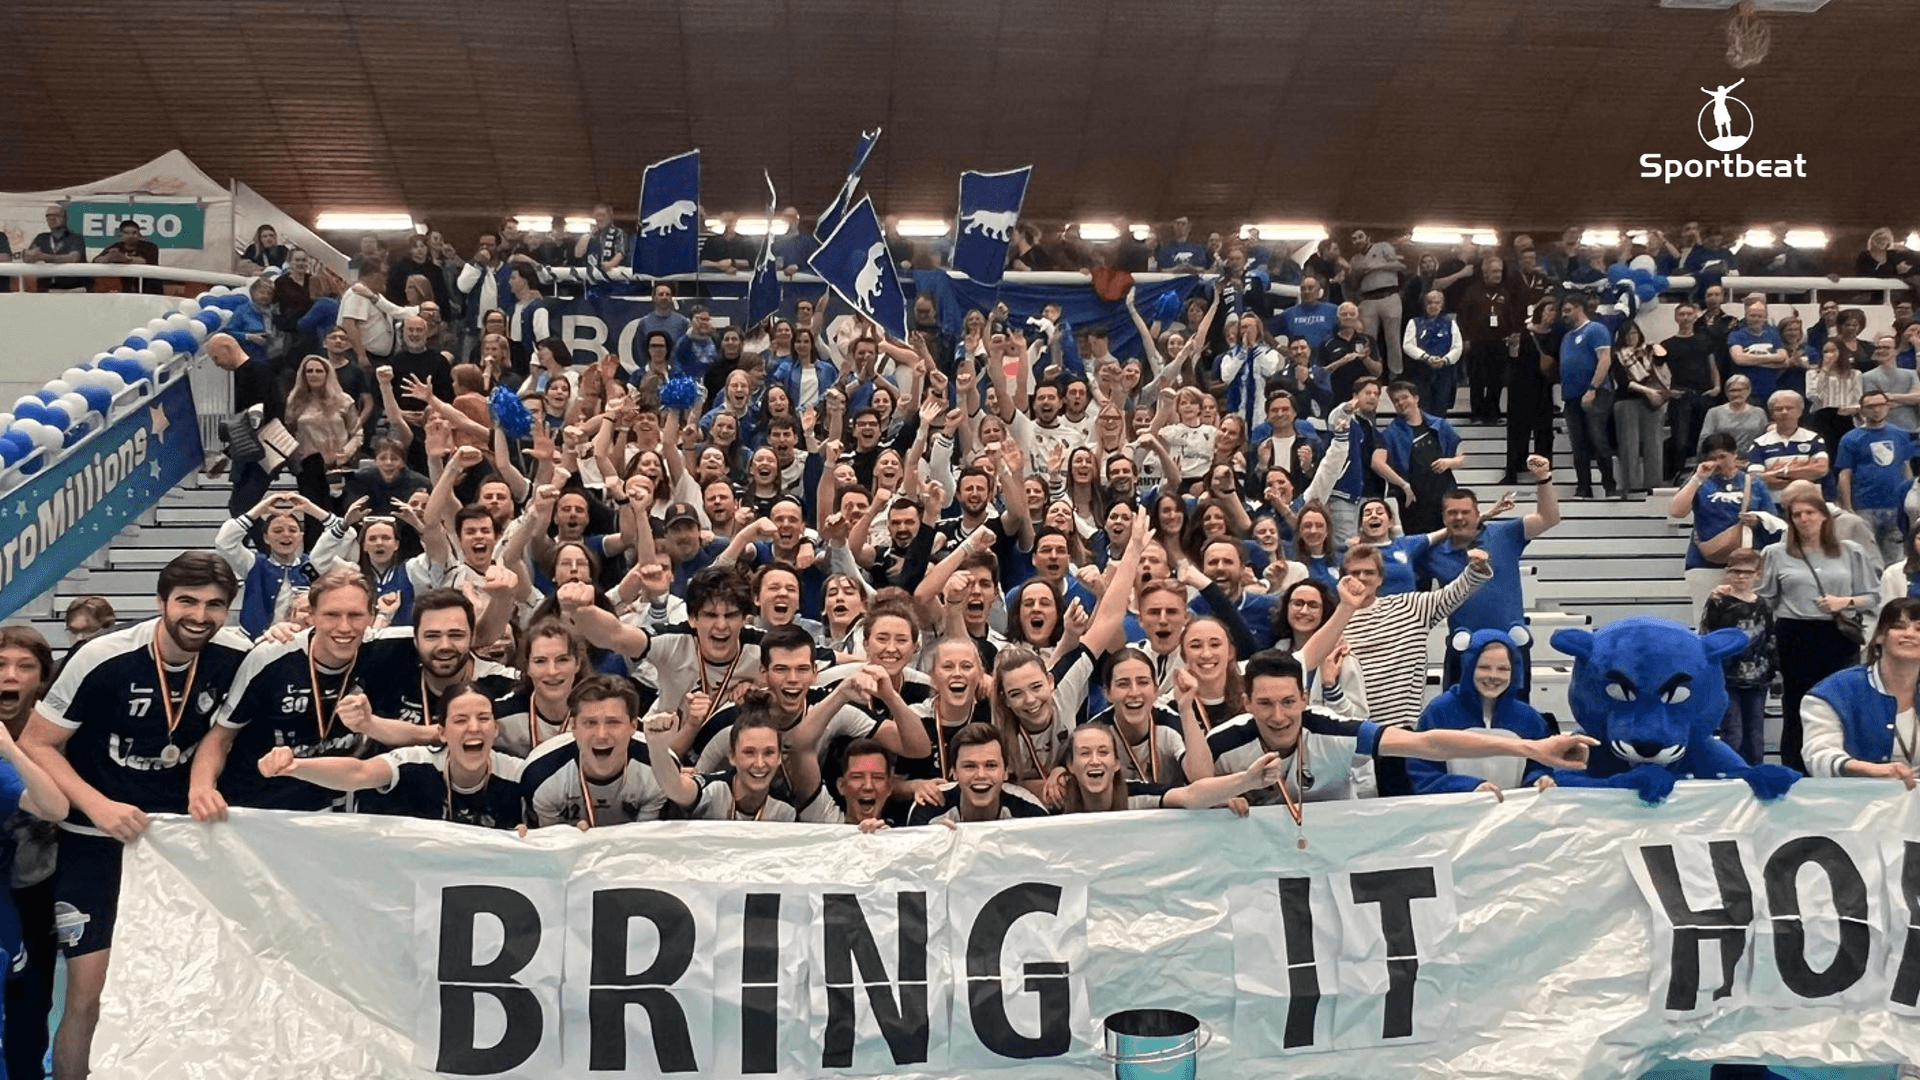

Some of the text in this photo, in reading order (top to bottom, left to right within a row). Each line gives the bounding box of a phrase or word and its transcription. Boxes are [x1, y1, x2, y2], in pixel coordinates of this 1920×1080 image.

[83, 213, 182, 238] EHBO
[0, 427, 147, 592] roMillions
[129, 698, 152, 716] 17
[282, 696, 308, 712] 30
[437, 882, 1072, 1077] BRING
[1278, 866, 1437, 1049] IT
